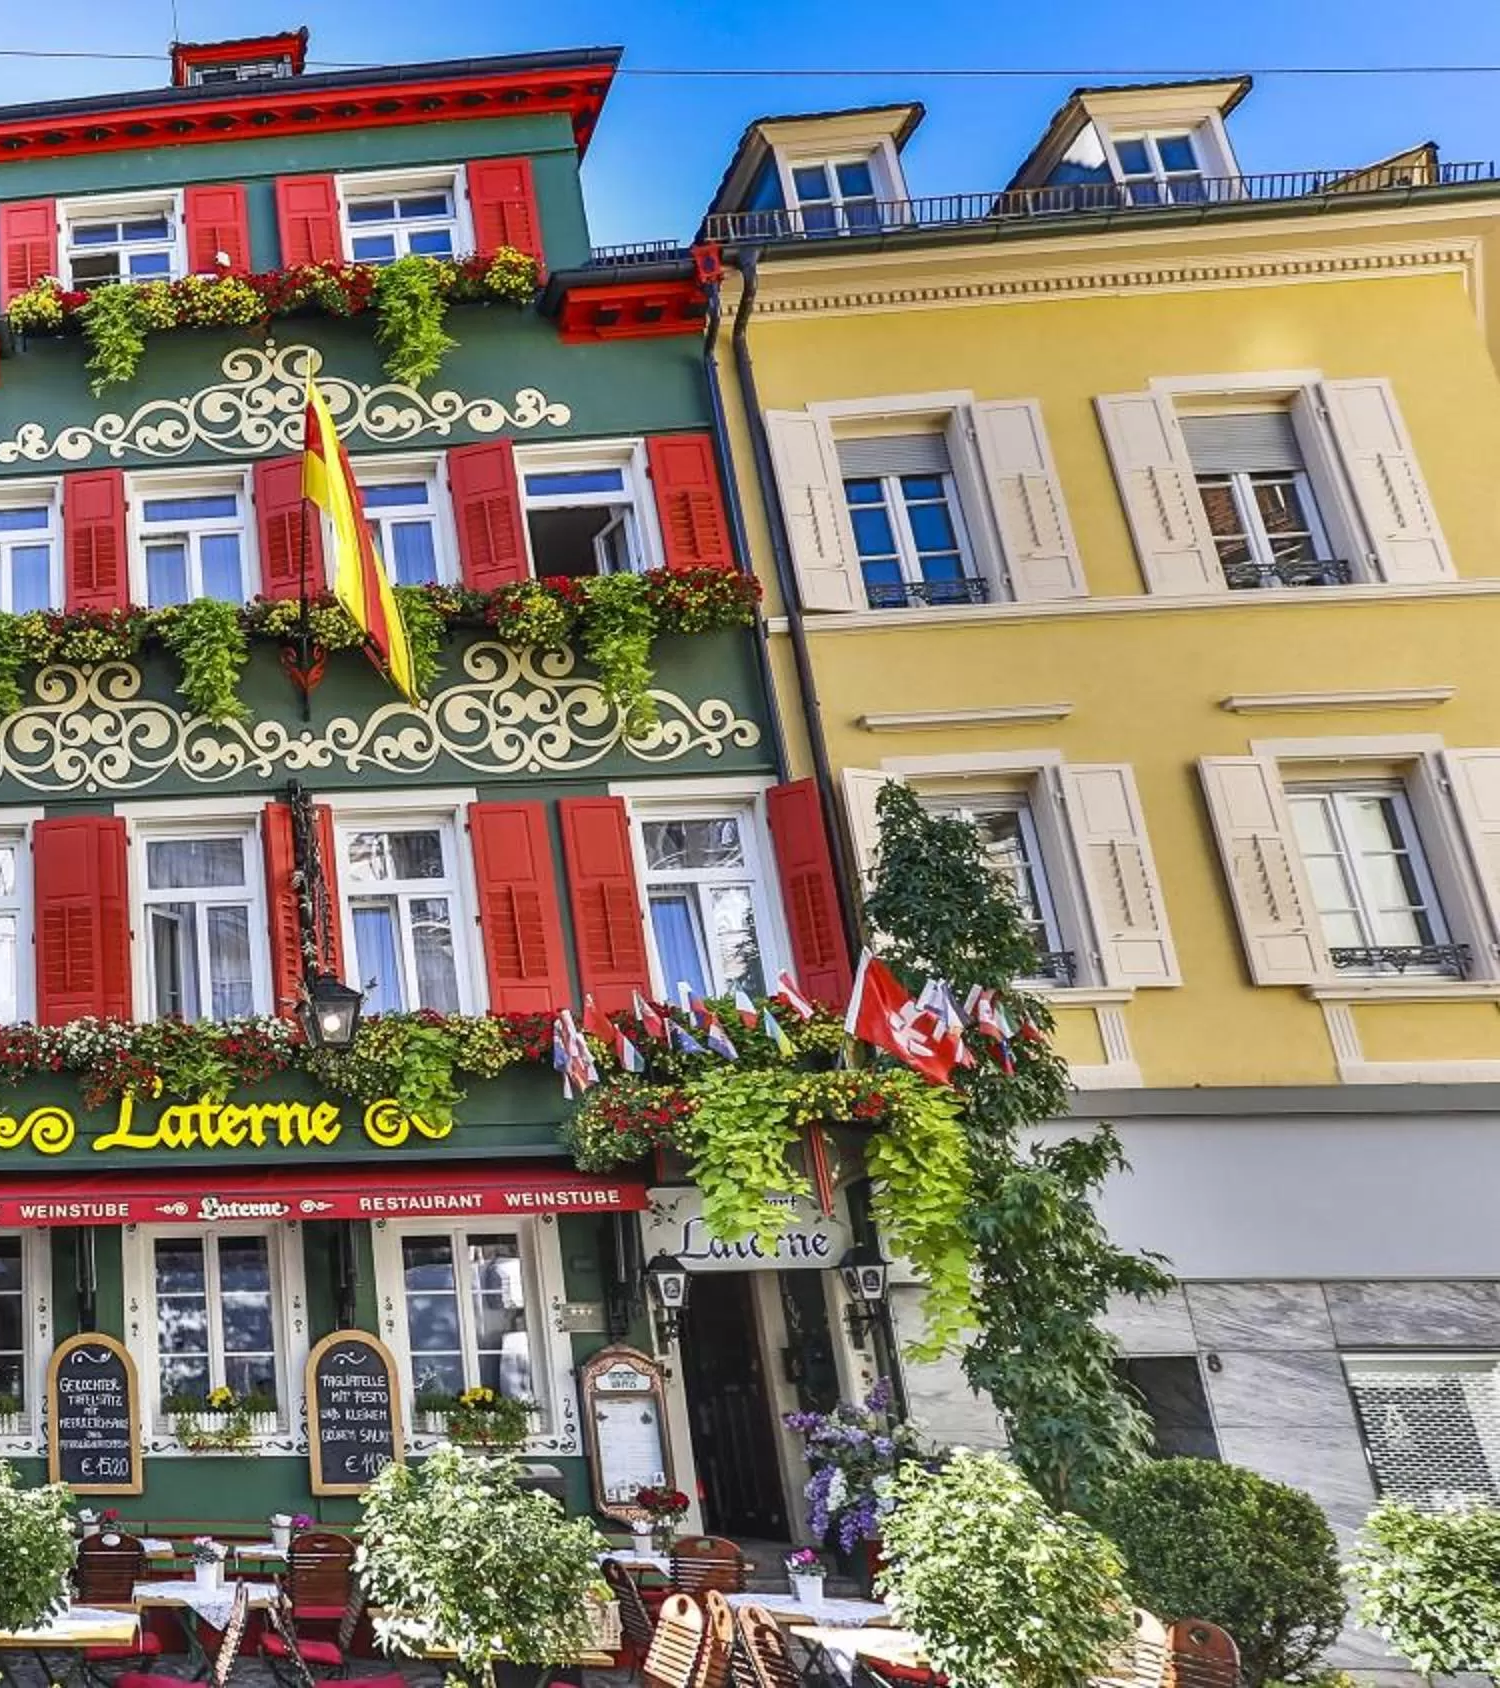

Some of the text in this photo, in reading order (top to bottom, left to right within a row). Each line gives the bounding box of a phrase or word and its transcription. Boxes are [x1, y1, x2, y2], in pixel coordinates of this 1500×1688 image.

[93, 1076, 342, 1152] Laterne
[20, 1203, 130, 1219] WEINSTUBE
[197, 1197, 291, 1220] Laterne
[360, 1189, 621, 1211] RESTAURANT WEINSTUBE
